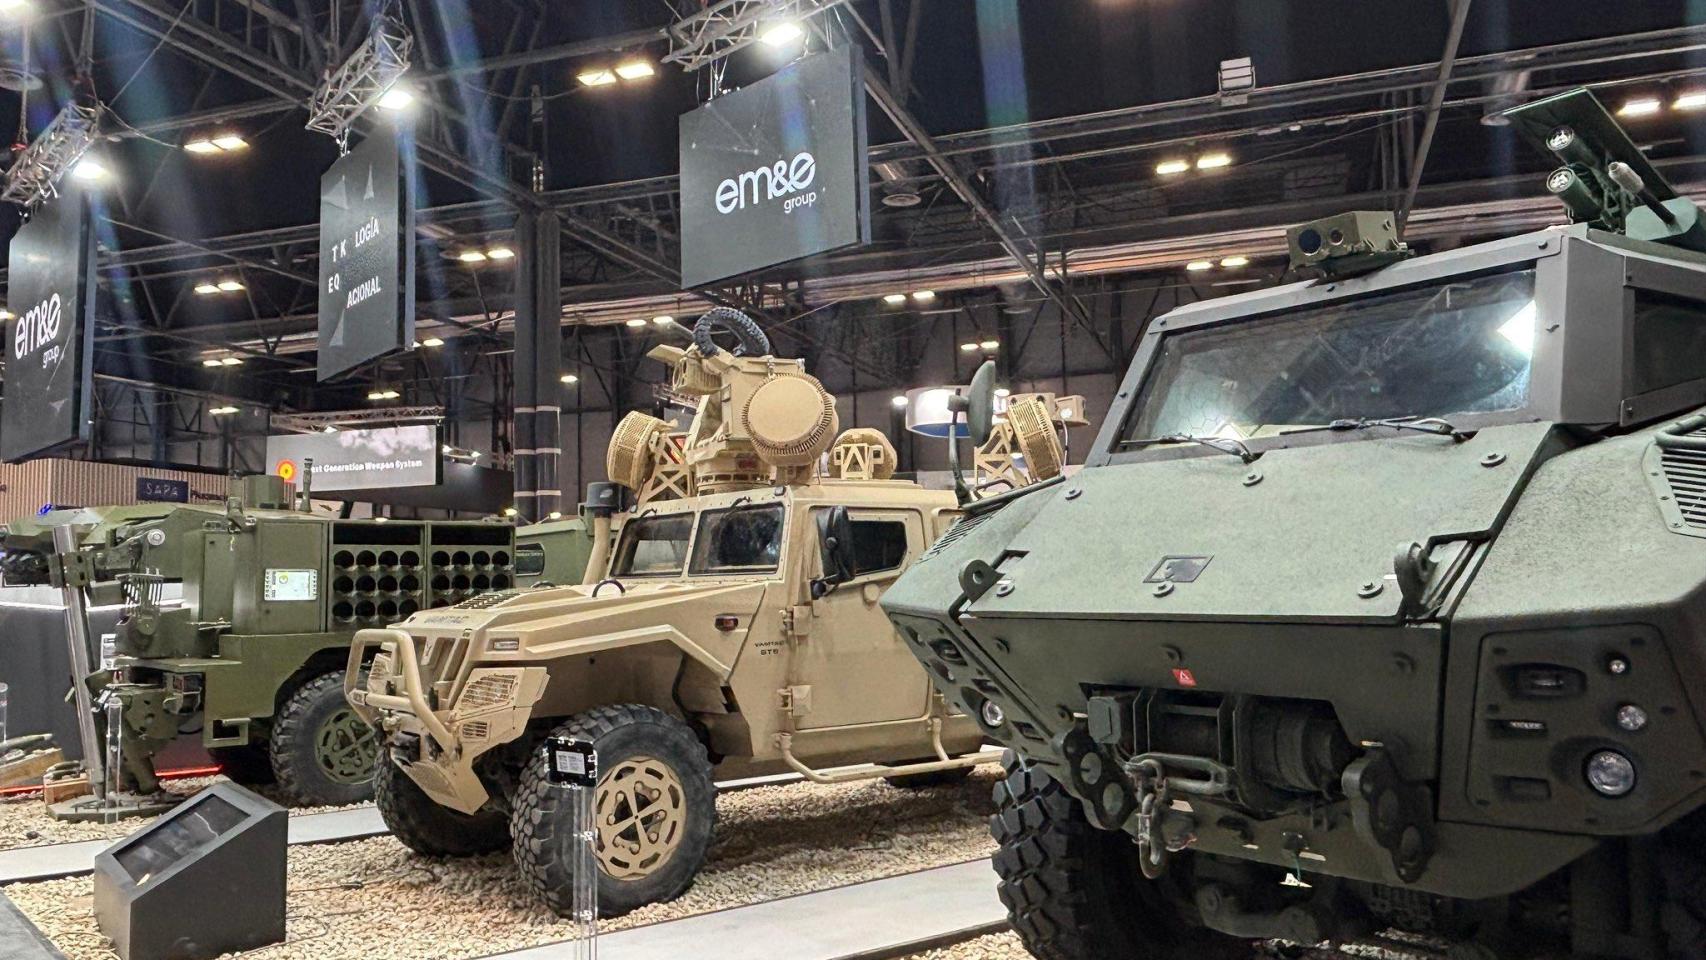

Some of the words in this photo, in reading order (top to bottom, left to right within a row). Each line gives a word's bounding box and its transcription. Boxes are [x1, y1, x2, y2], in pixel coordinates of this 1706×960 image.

[715, 152, 816, 214] em&e
[783, 191, 817, 214] group
[354, 216, 380, 248] LOGÍA
[346, 275, 381, 309] ACIONAL
[15, 292, 62, 360] em&e
[42, 345, 60, 369] group
[323, 463, 365, 473] Generation
[364, 461, 395, 471] Weapon
[395, 459, 423, 470] System
